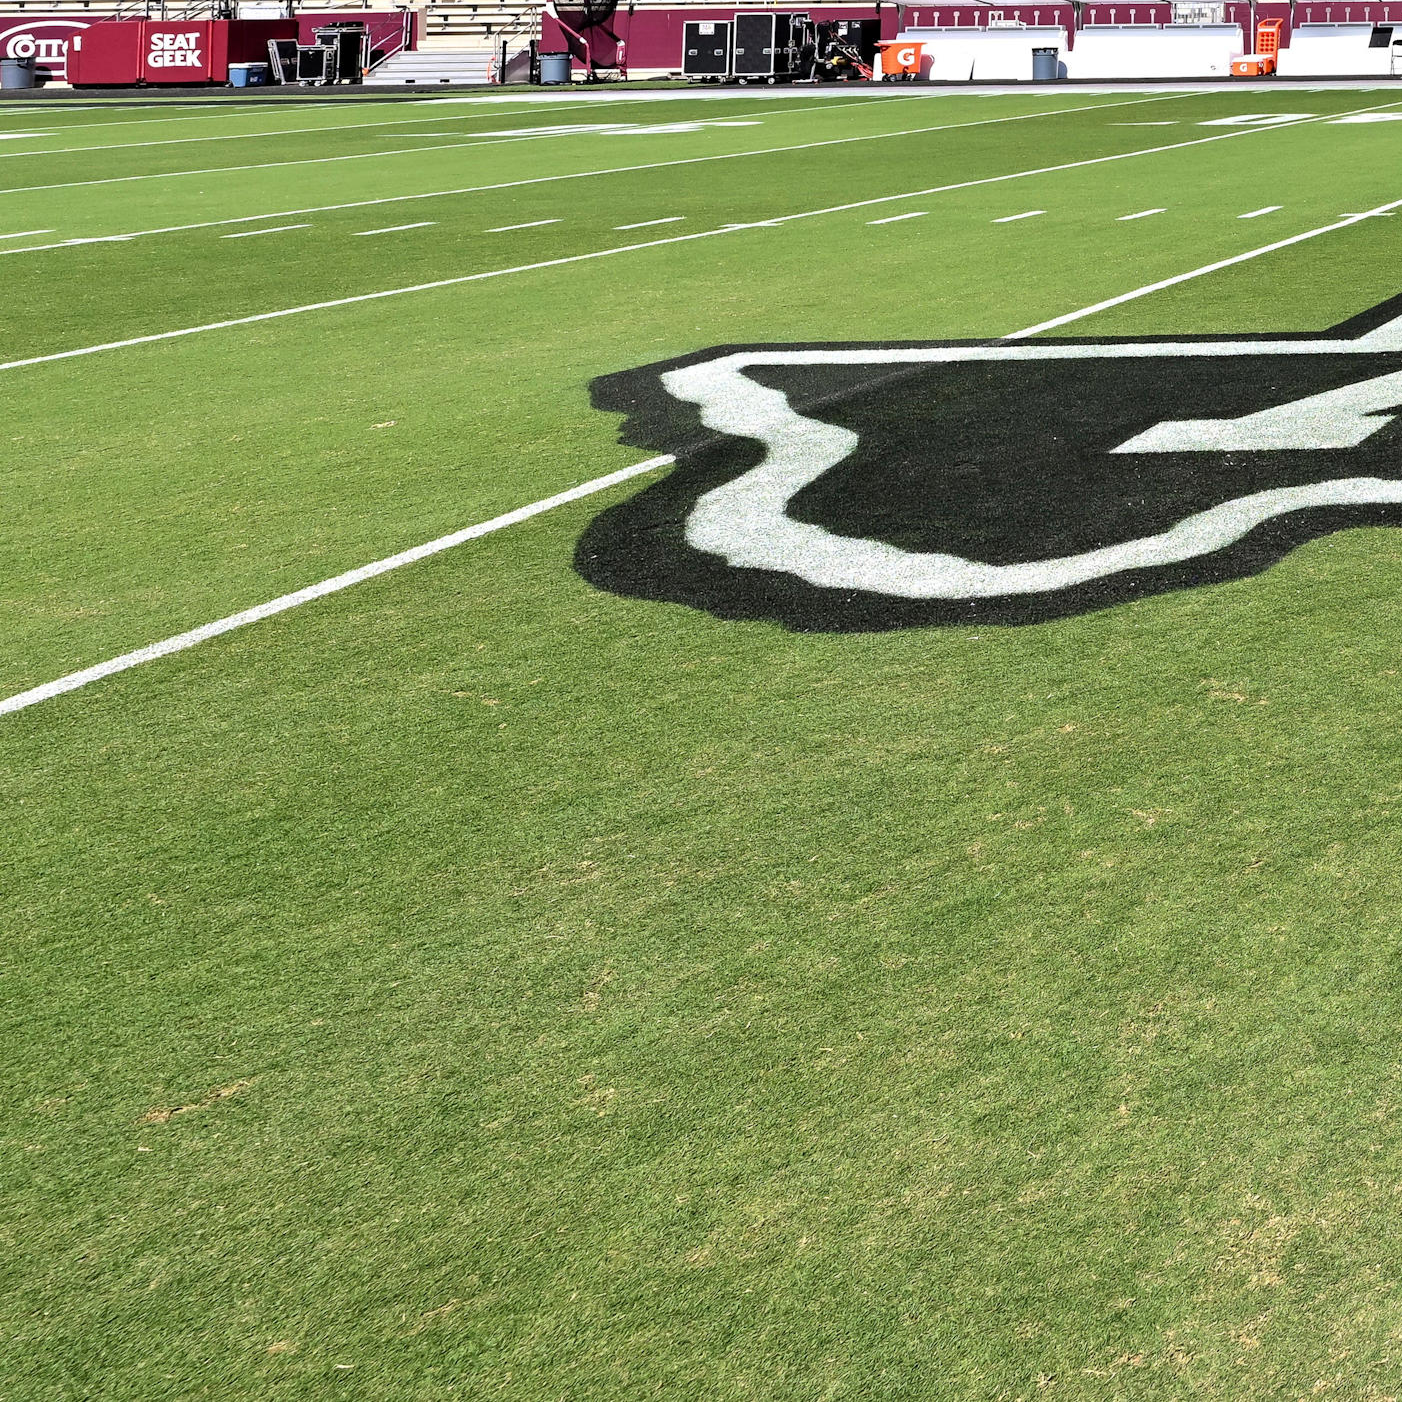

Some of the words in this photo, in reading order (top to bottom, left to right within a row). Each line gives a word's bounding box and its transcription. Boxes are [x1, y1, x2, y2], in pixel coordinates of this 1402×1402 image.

[151, 32, 200, 50] SEAT
[148, 50, 202, 67] GEEK
[897, 48, 915, 66] G
[1240, 63, 1248, 72] G
